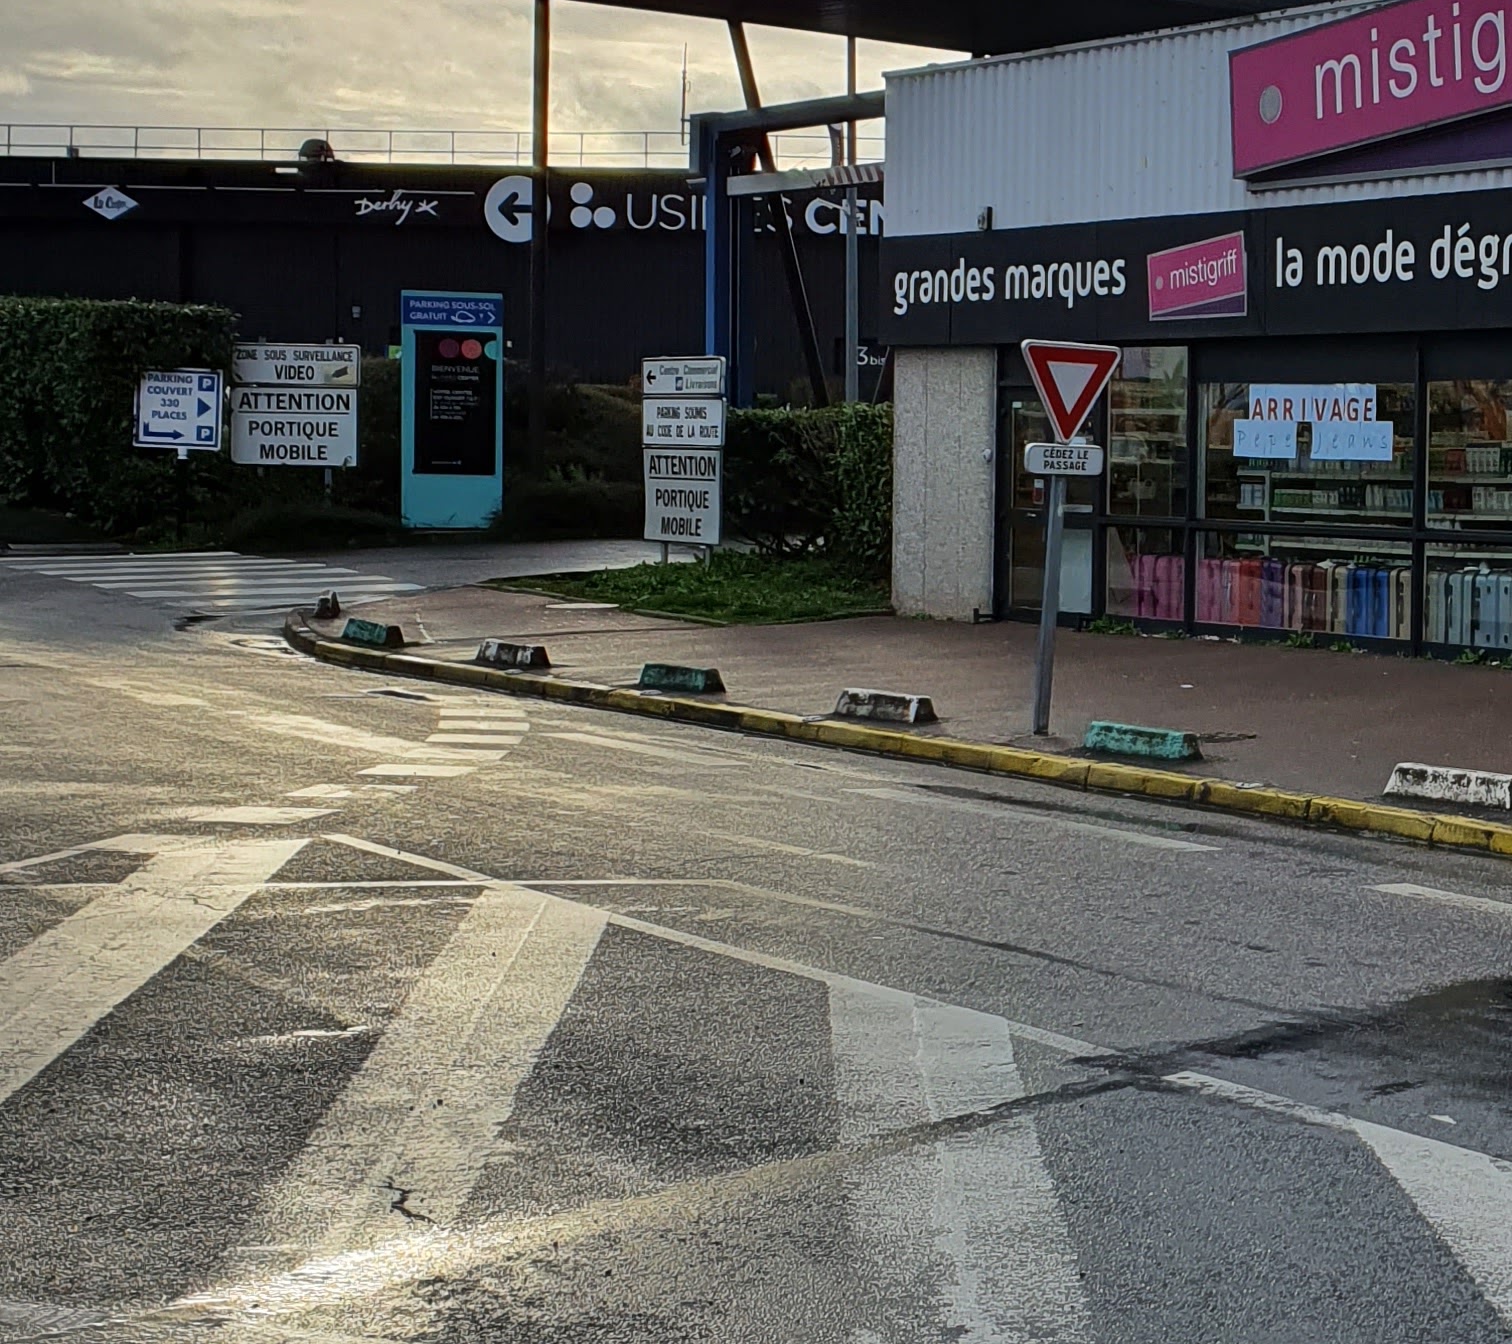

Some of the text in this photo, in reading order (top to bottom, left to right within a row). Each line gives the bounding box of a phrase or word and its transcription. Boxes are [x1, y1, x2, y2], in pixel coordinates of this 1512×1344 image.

[1276, 237, 1304, 288] la
[1316, 229, 1416, 286] mode
[1169, 248, 1238, 290] mistigriff
[893, 257, 1127, 316] grandes marques
[409, 300, 496, 311] PARKING SOUS-SOL
[409, 312, 447, 321] GRATUIT
[264, 349, 287, 361] SOUS
[293, 350, 354, 362] SURVEILLANCE
[147, 373, 193, 384] PARKING
[274, 364, 315, 381] VIDEO
[147, 385, 193, 396] COUVERT
[239, 392, 351, 411] ATTENTION
[1251, 397, 1374, 422] ARRIVAGE
[151, 410, 187, 420] PLACES
[248, 420, 340, 441] PORTIQUE
[259, 443, 328, 461] MOBILE
[1043, 447, 1089, 460] CÉDEZ LE
[649, 455, 717, 477] ATTENTION
[1043, 460, 1087, 471] PASSAGE
[655, 488, 710, 512] PORTIQUE
[661, 516, 702, 537] MOBILE
